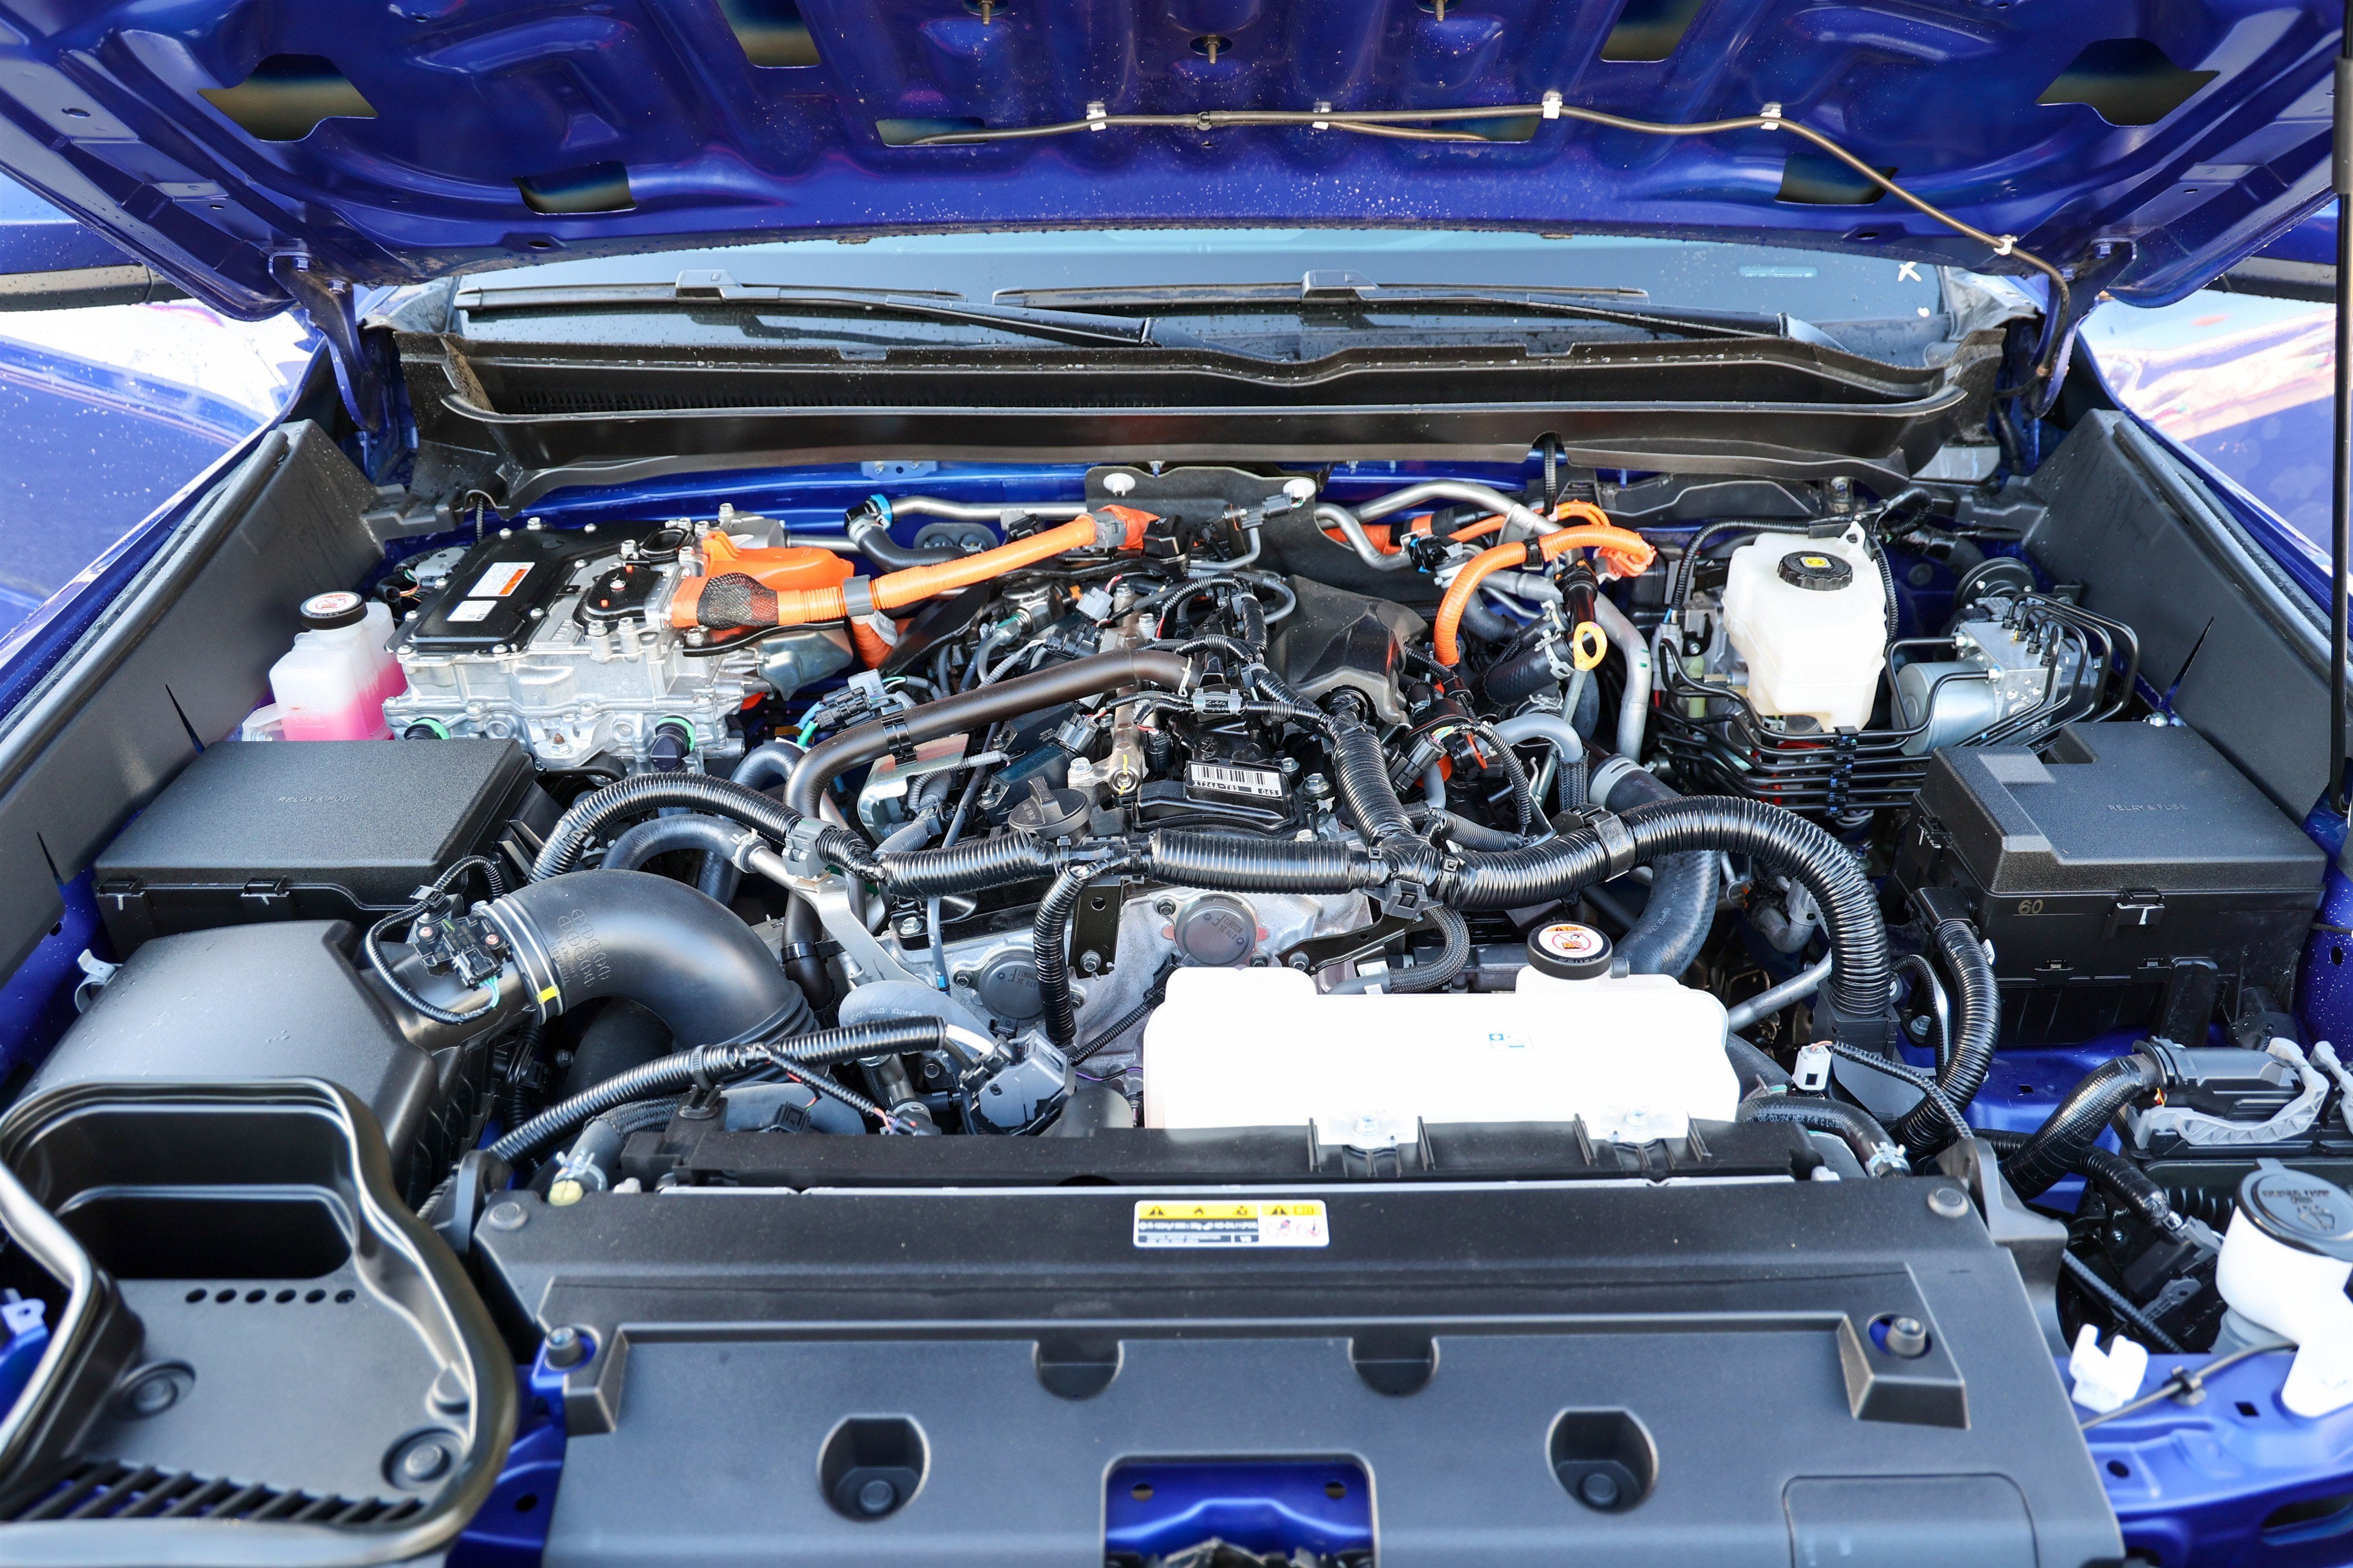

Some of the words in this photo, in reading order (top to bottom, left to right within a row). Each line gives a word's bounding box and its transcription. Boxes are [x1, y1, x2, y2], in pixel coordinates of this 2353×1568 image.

[1039, 728, 1054, 736] TOYOTA
[1042, 733, 1055, 742] DENSO
[1193, 780, 1239, 791] XT24A-T83
[2018, 899, 2043, 914] 60
[1212, 914, 1226, 926] F
[1008, 968, 1017, 982] F
[891, 1007, 911, 1017] WATER
[1757, 1113, 1789, 1122] 08/03/24
[1793, 1114, 1804, 1122] MEX
[1808, 1115, 1819, 1125] F/R
